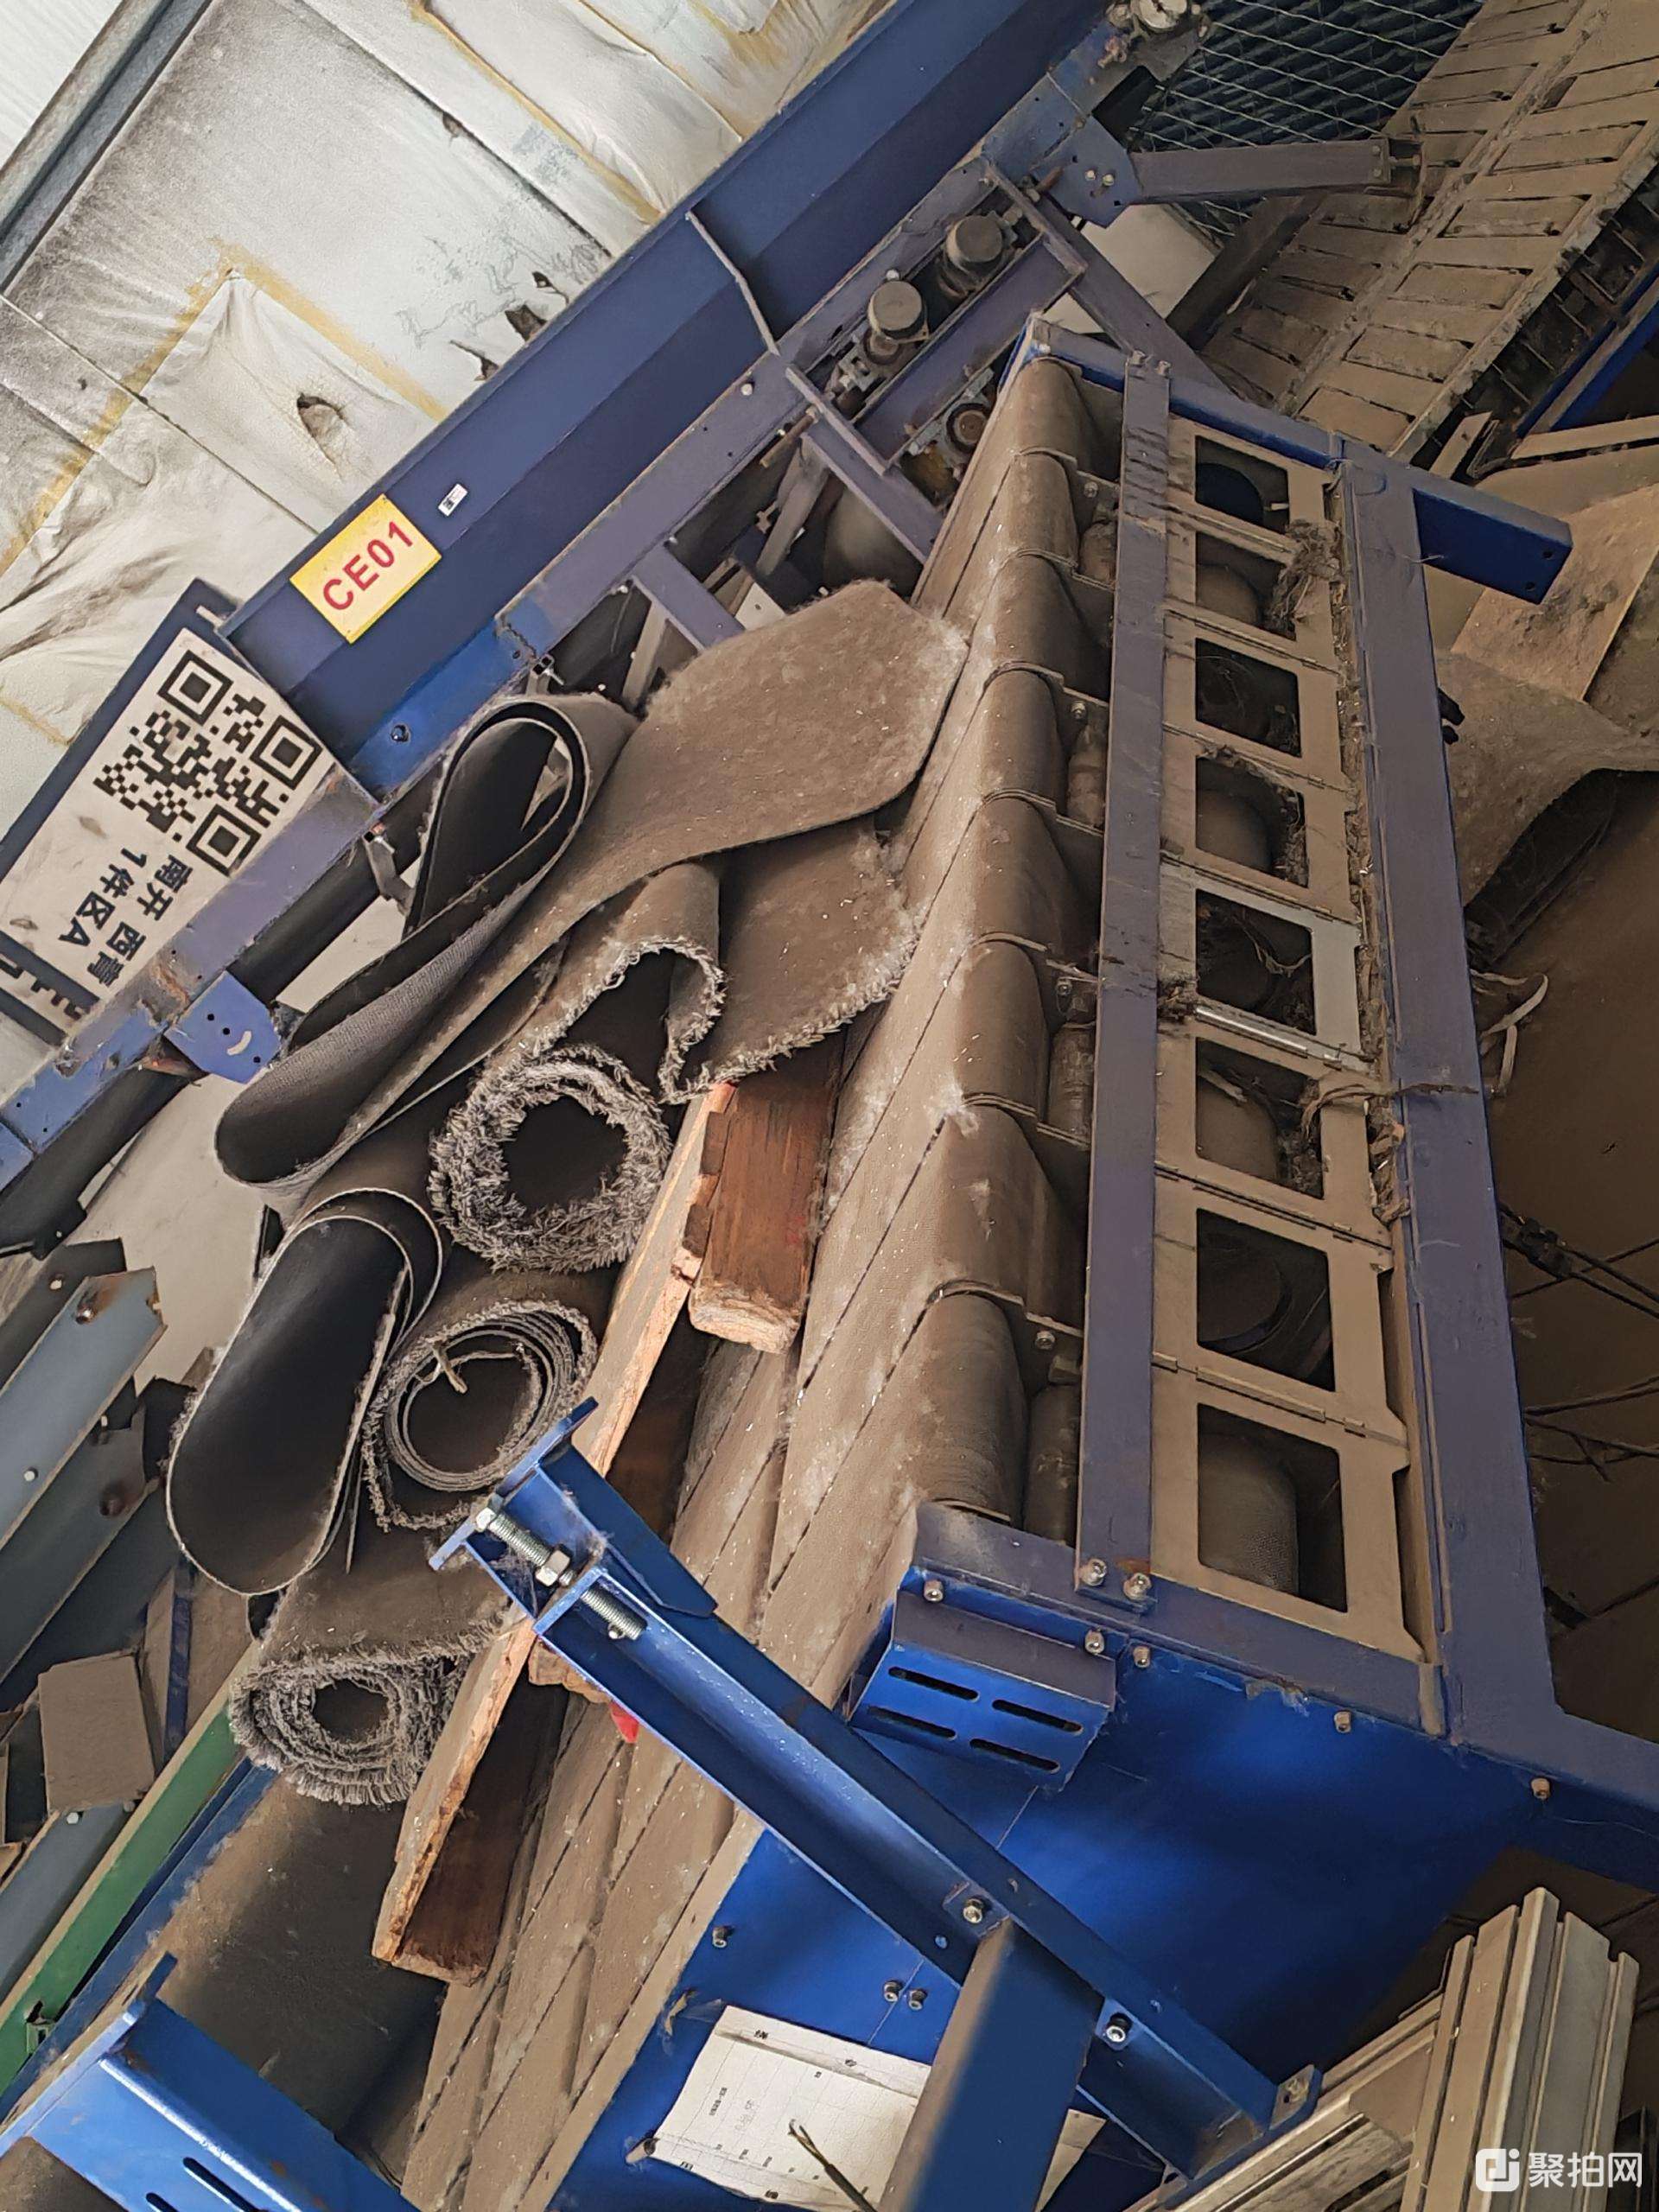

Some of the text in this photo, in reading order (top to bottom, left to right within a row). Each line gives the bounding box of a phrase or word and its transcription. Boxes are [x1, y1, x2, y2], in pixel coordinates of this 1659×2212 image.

[324, 521, 413, 610] CE01
[87, 854, 193, 988] 南开 西青
